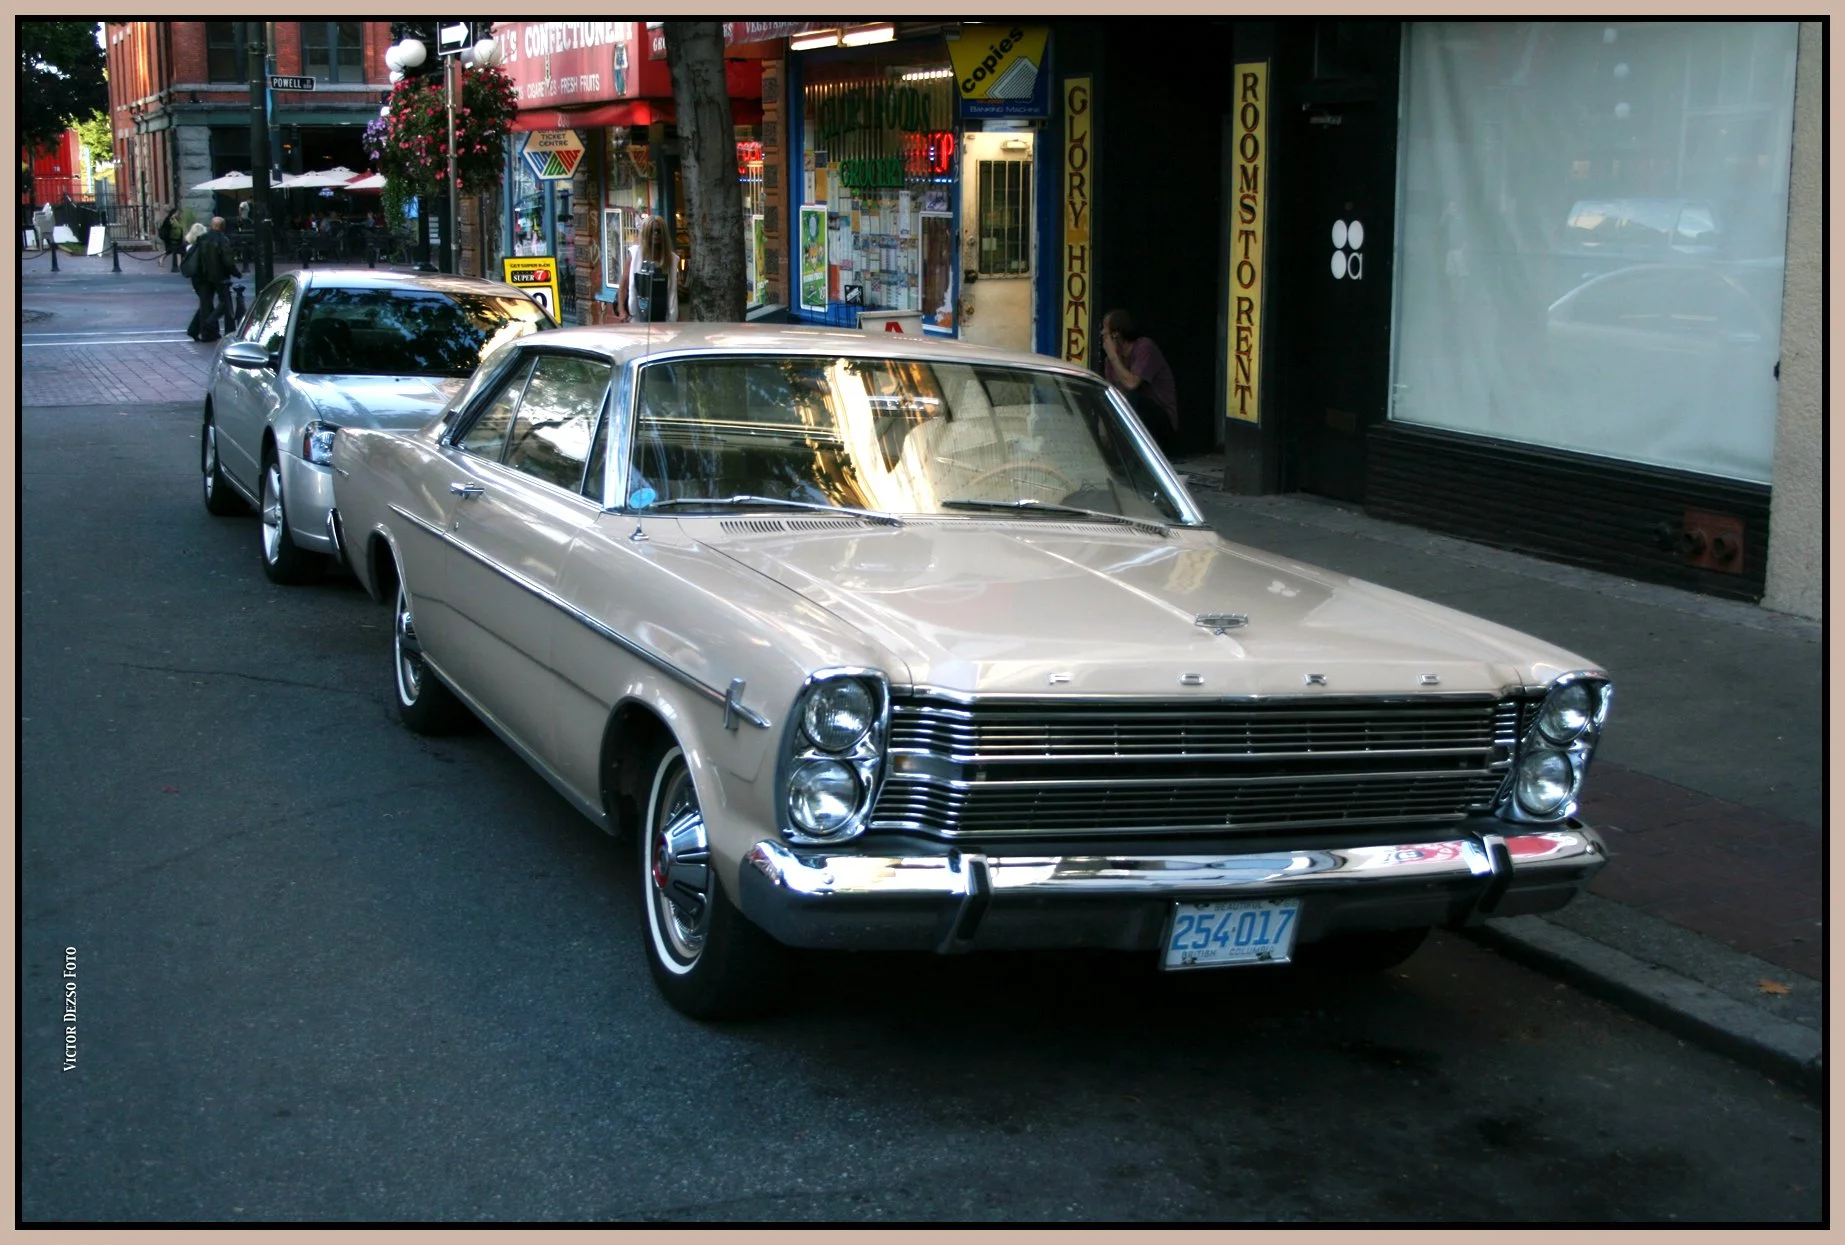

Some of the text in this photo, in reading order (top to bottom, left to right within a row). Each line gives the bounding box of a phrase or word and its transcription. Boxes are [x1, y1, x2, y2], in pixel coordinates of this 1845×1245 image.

[961, 28, 1023, 93] copies
[273, 78, 302, 88] POWELL
[561, 76, 578, 94] FRESH
[580, 73, 600, 92] FRUITS
[1065, 85, 1089, 361] GLORY HOTE
[1234, 72, 1260, 416] ROOMS TO RENT
[536, 270, 544, 280] 7
[1047, 672, 1440, 685] FORD
[1214, 901, 1264, 911] BEAUTIFUL
[1182, 946, 1275, 959] BRITISH COLUMBIA
